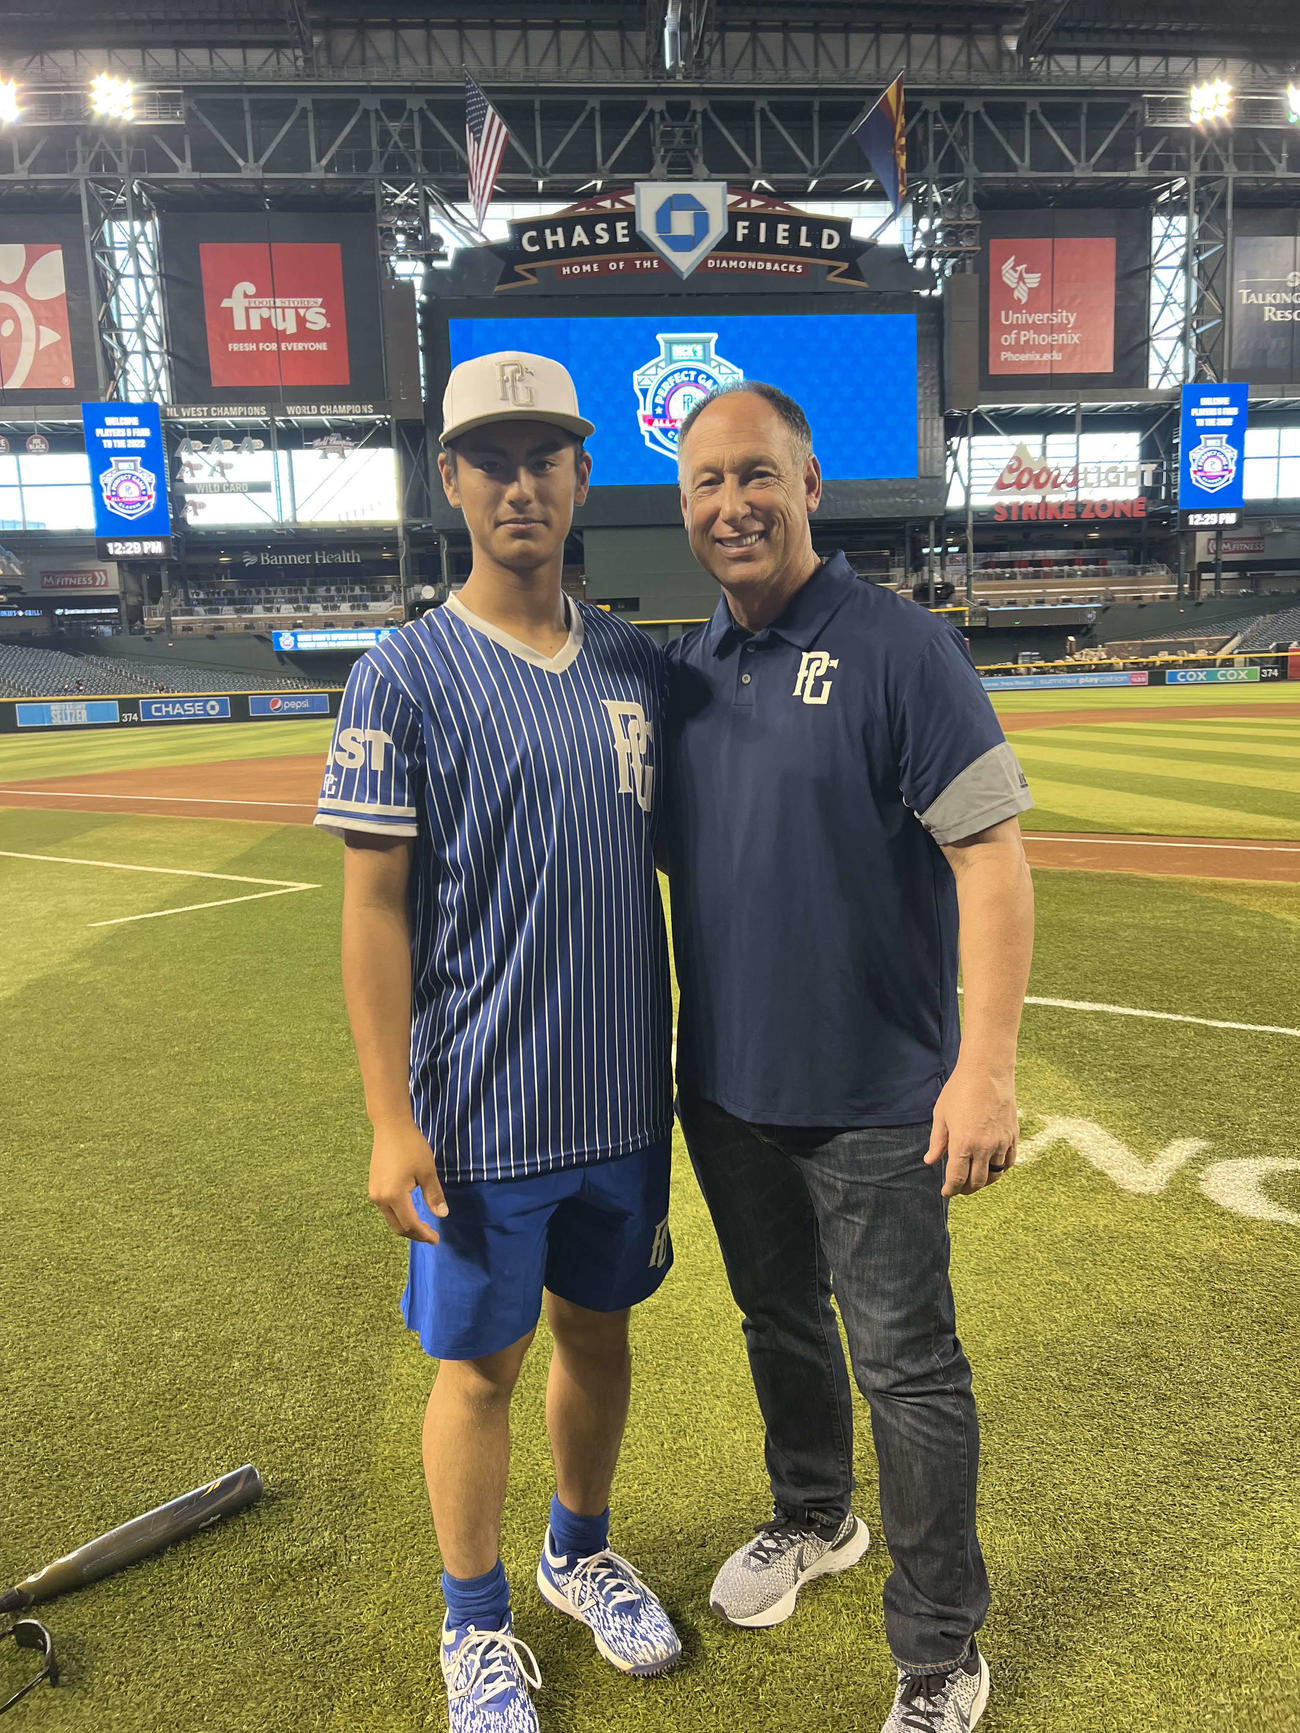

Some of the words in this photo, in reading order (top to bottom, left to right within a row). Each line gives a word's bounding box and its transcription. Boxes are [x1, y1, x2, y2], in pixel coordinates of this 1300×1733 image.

[521, 221, 630, 252] CHASE
[736, 221, 841, 250] FIELD
[562, 263, 600, 275] HOME
[609, 261, 625, 271] OF
[634, 259, 659, 269] THE
[707, 259, 803, 273] DIAMONDBACKS
[220, 281, 327, 335] fry's
[279, 299, 320, 307] STORES
[1001, 309, 1077, 328] University
[1001, 330, 1018, 346] of
[1020, 330, 1081, 345] Phoenix
[228, 343, 257, 352] FRESH
[259, 342, 278, 352] FOR
[281, 342, 328, 352] EVERYONE
[1001, 351, 1063, 361] Phoenix.edu
[654, 371, 697, 405] PERFECT
[166, 407, 179, 417] NL
[181, 407, 208, 417] WEST
[211, 406, 267, 417] CHAMPIONS
[286, 405, 317, 415] WORLD
[320, 404, 373, 415] CHAMPIONS
[994, 455, 1080, 492] Coors
[1083, 462, 1159, 488] LIGHT
[195, 482, 220, 493] WILD
[223, 482, 248, 493] CARD
[994, 499, 1077, 521] STRIKE
[1080, 496, 1148, 519] ZONE
[1219, 512, 1237, 524] PM
[106, 541, 142, 555] 12:29
[142, 541, 163, 554] PM
[260, 551, 312, 565] Banner
[315, 549, 361, 564] Health
[55, 576, 93, 585] FITNESS
[1177, 671, 1207, 682] COX
[1217, 670, 1248, 680] COX
[1261, 668, 1279, 678] 374
[151, 702, 204, 716] CHASE
[283, 699, 309, 711] pepsi
[121, 713, 138, 723] 374
